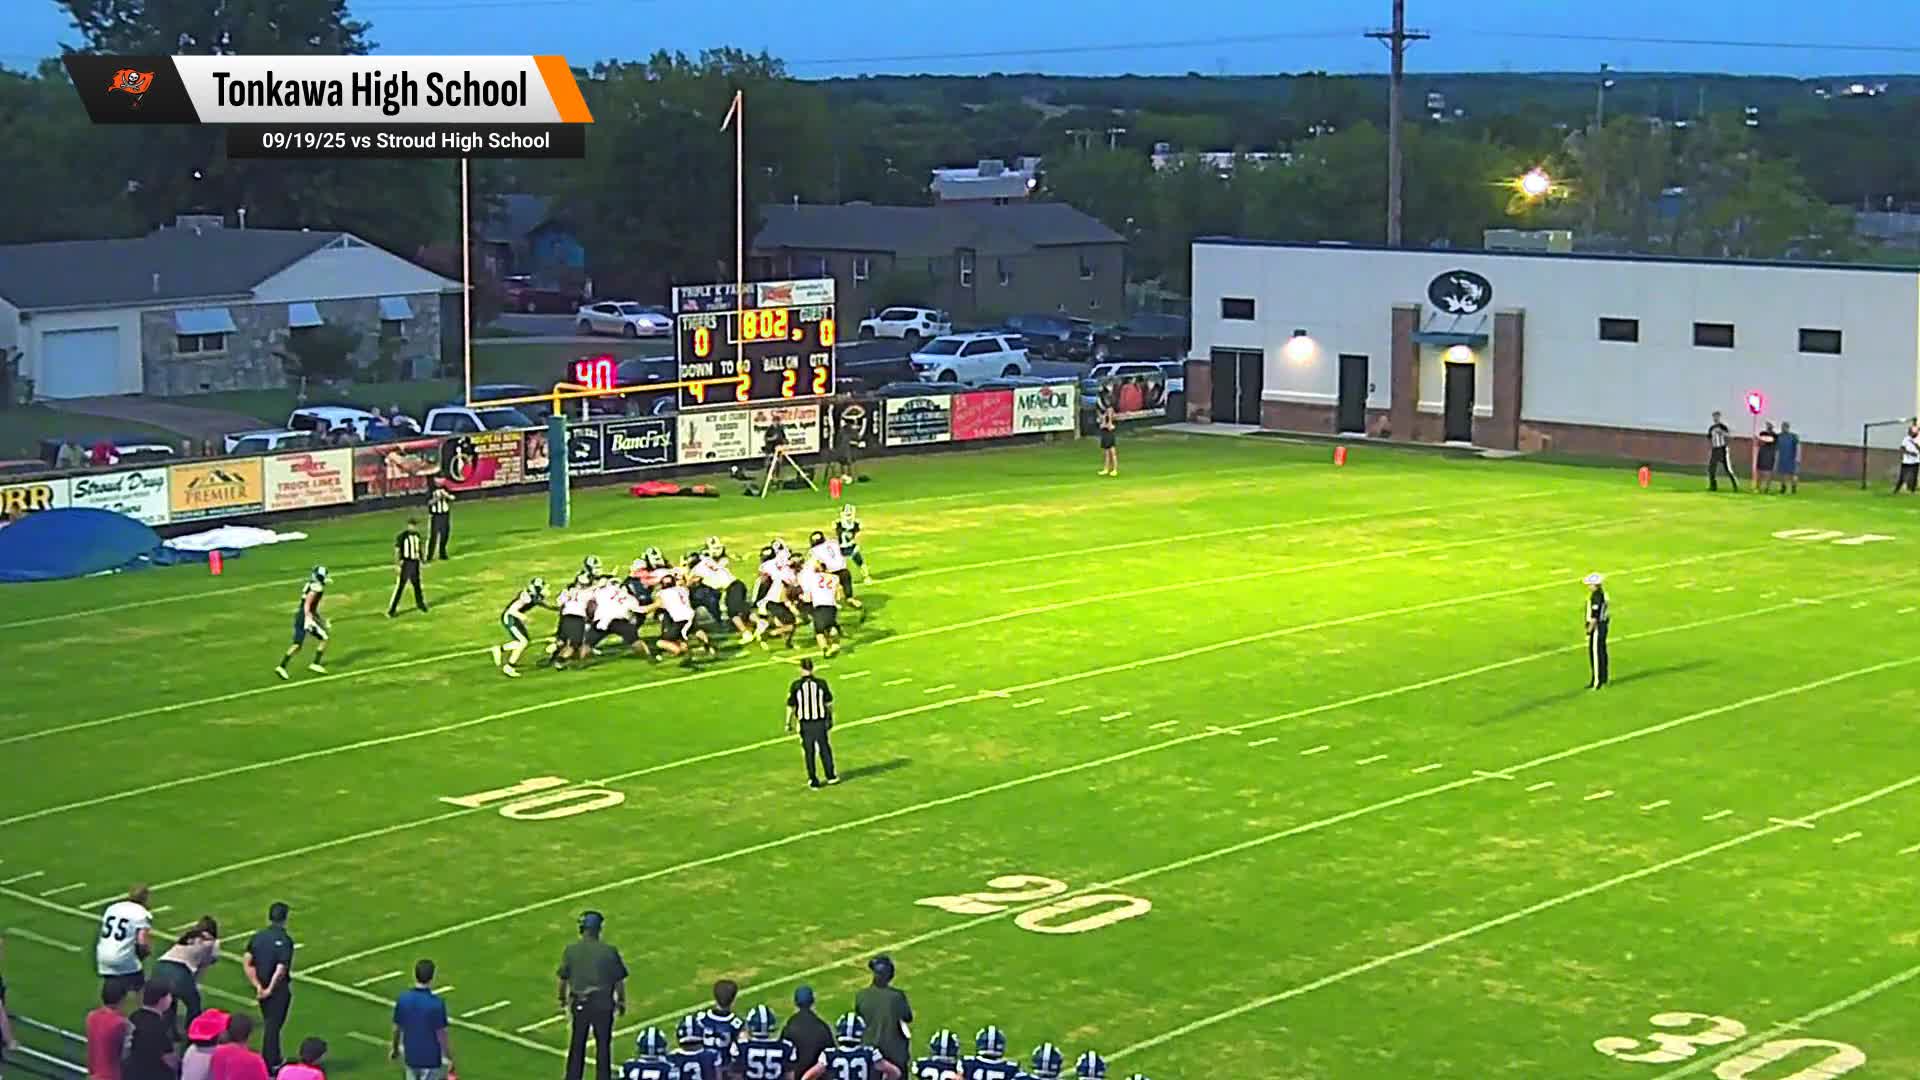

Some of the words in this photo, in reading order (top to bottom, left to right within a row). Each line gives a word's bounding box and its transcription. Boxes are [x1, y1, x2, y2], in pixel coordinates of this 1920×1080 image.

[683, 315, 717, 330] TIGERS
[820, 319, 834, 347] 0
[694, 328, 709, 357] 0
[681, 363, 713, 377] DOWN
[721, 361, 734, 375] TO
[764, 357, 784, 371] BALL
[786, 356, 799, 368] ON
[810, 353, 830, 367] QTR
[736, 374, 750, 401] 2
[782, 370, 796, 398] 2
[813, 367, 827, 394] 2
[1049, 393, 1069, 409] OIL
[1022, 415, 1064, 428] Propane
[74, 479, 122, 498] Stroud
[127, 472, 164, 491] Drug
[185, 486, 248, 504] PREMIER
[438, 776, 624, 820] 10
[913, 875, 1152, 934] 20
[102, 916, 128, 941] 55
[1593, 1012, 1867, 1080] 30
[747, 1049, 784, 1080] 55
[832, 1057, 867, 1080] 33
